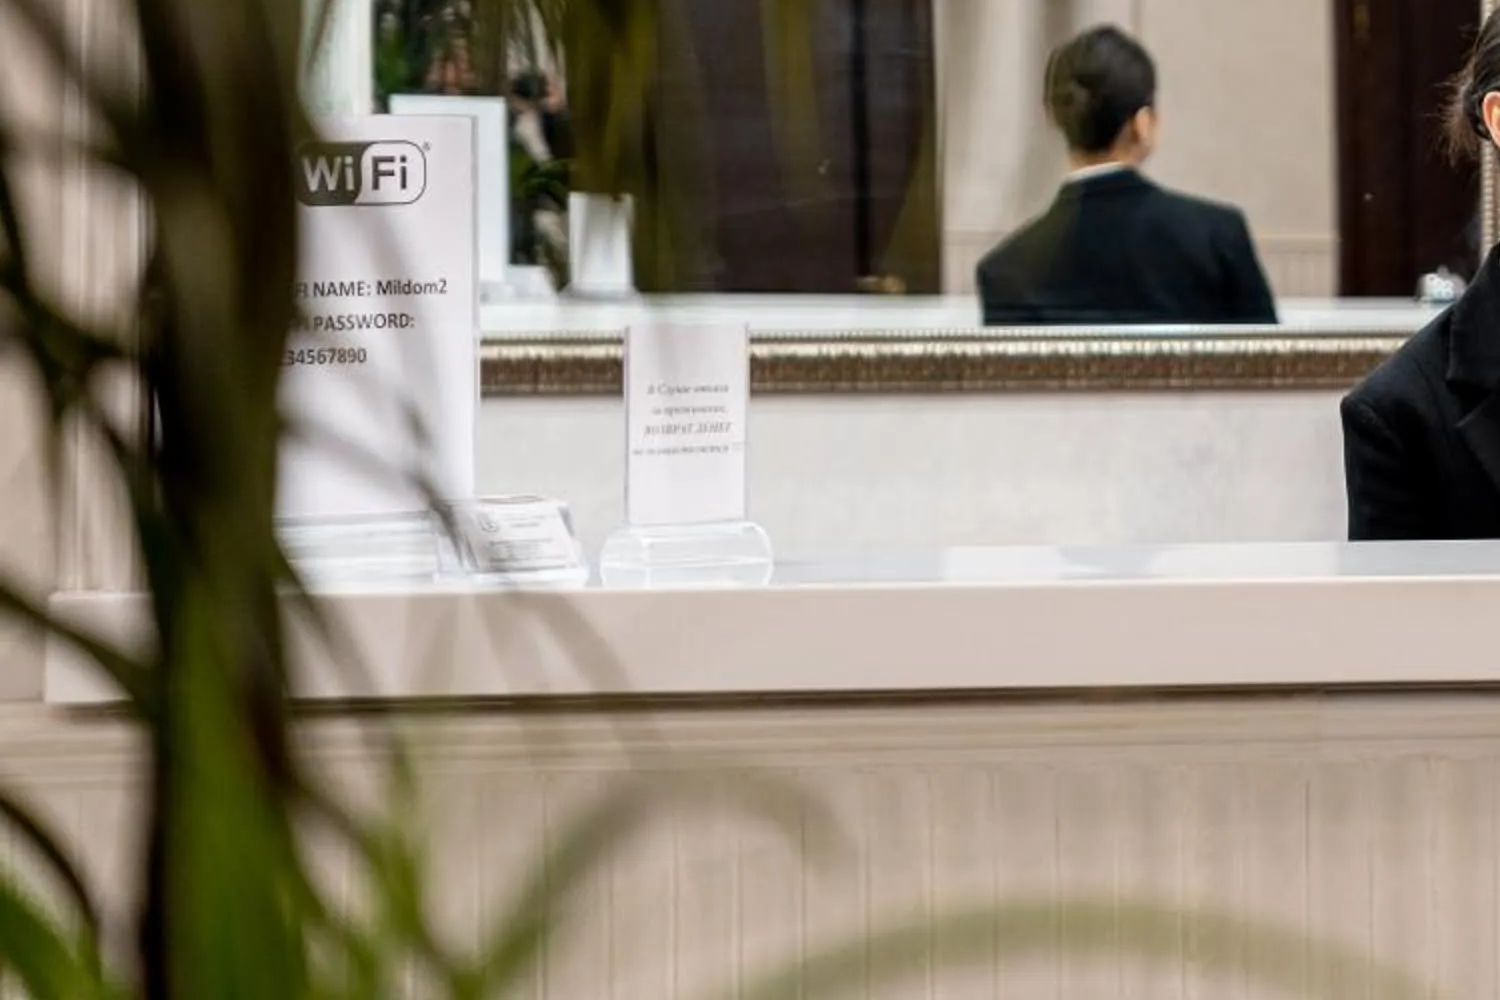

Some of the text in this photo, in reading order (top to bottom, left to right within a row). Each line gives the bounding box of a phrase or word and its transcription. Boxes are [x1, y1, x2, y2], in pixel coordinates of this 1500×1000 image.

[313, 281, 371, 297] NAME:
[376, 278, 447, 296] Mildom2
[313, 313, 415, 332] PASSWORD:
